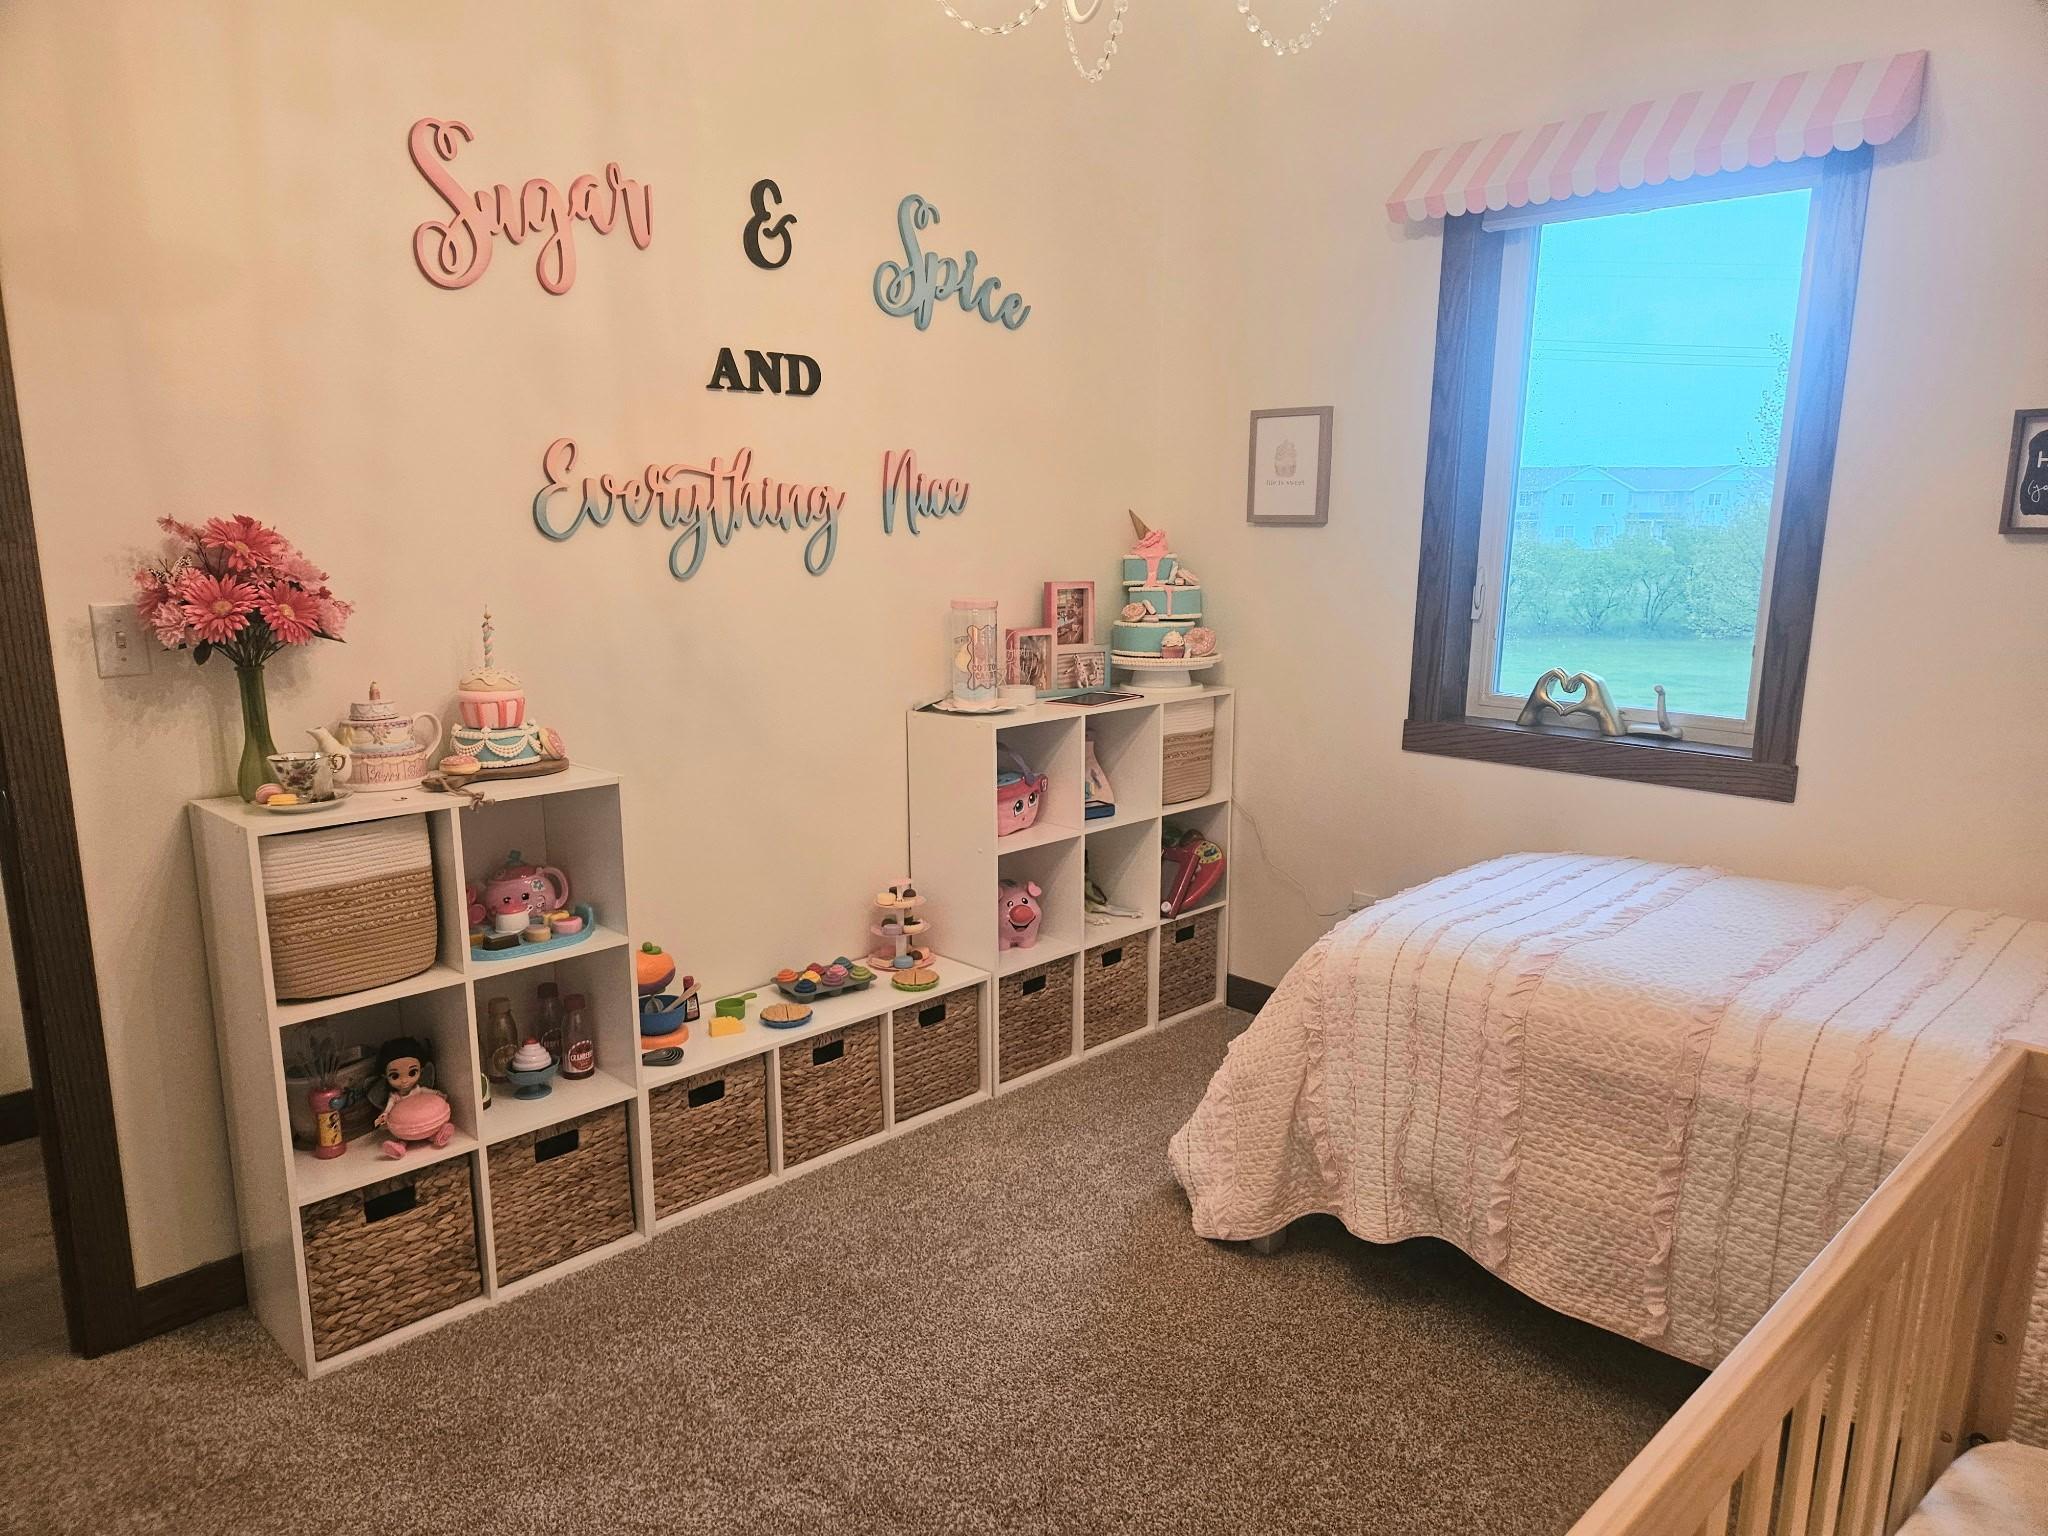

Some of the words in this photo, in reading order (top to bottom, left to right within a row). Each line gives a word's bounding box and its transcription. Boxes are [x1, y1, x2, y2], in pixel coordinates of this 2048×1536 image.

[408, 117, 653, 296] Sugar
[743, 178, 797, 269] &
[873, 194, 1031, 331] Spice
[706, 347, 822, 396] AND
[533, 437, 847, 581] Everything
[883, 449, 969, 535] Nice
